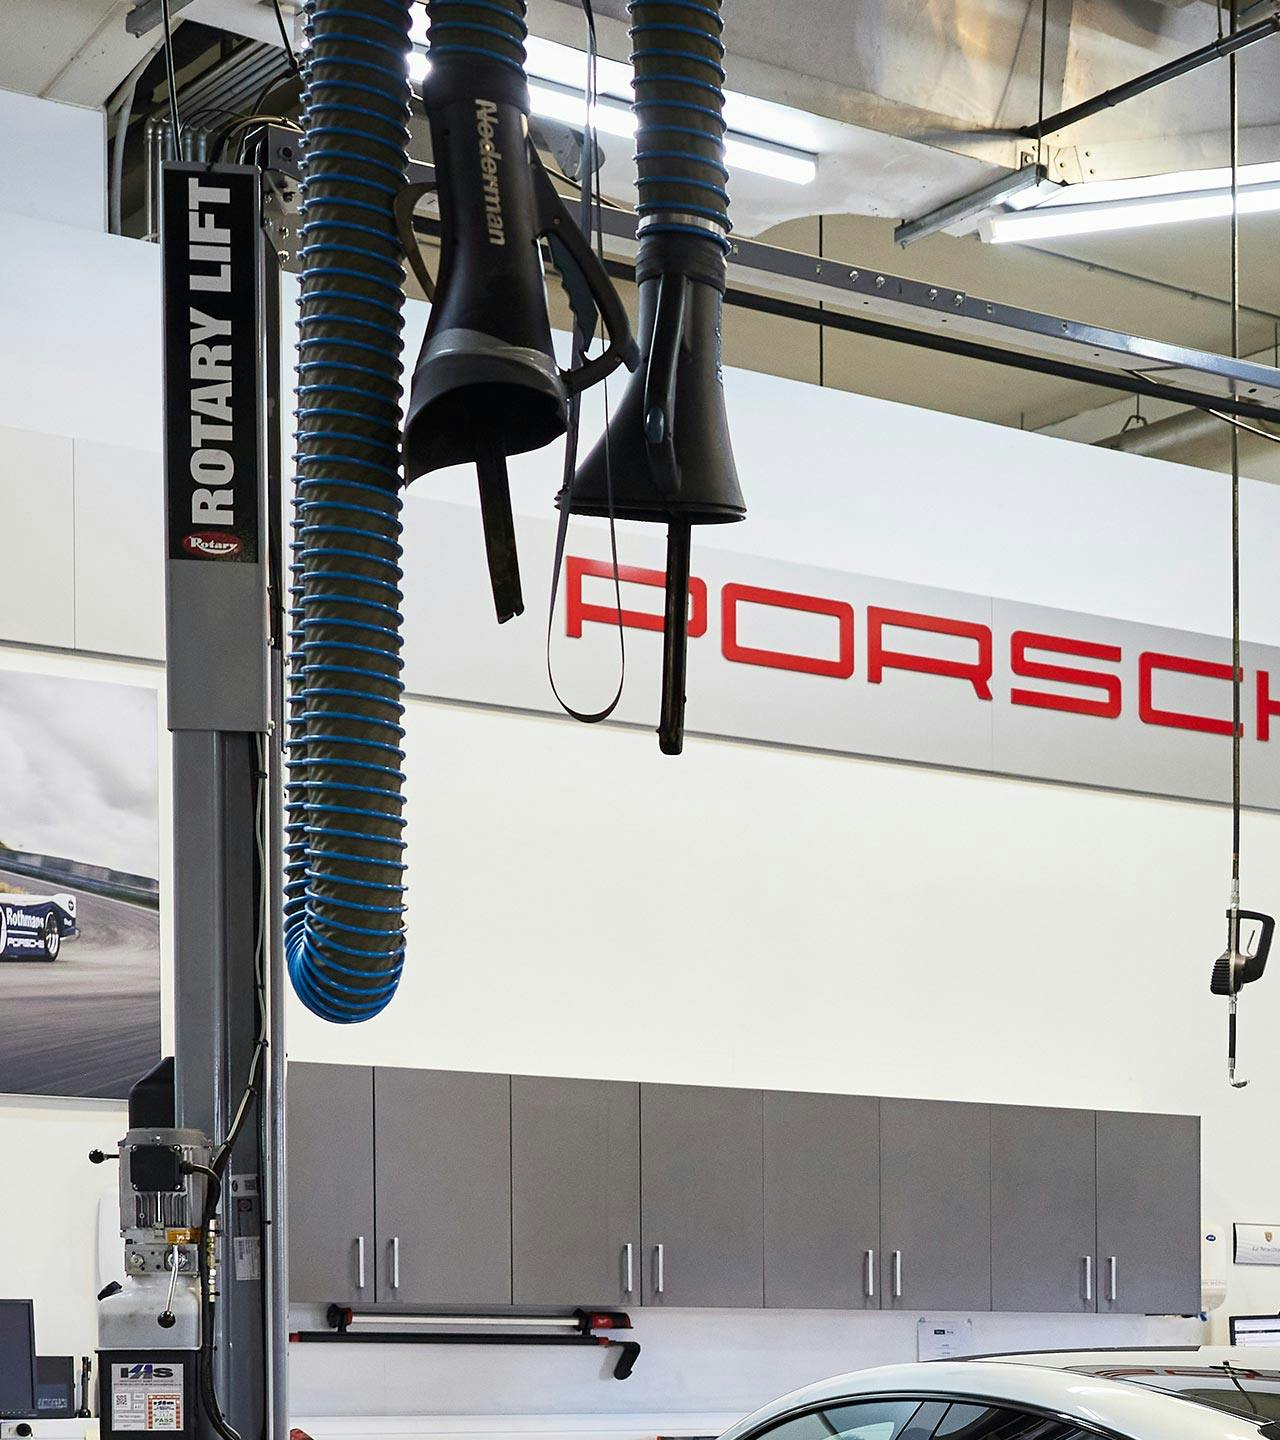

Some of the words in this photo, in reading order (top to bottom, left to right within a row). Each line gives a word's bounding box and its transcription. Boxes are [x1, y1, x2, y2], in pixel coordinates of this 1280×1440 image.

[475, 98, 505, 246] Nederman
[188, 177, 231, 292] LIFT
[189, 306, 235, 526] ROTARY
[189, 535, 239, 554] Rotary
[6, 907, 45, 929] Rothmans
